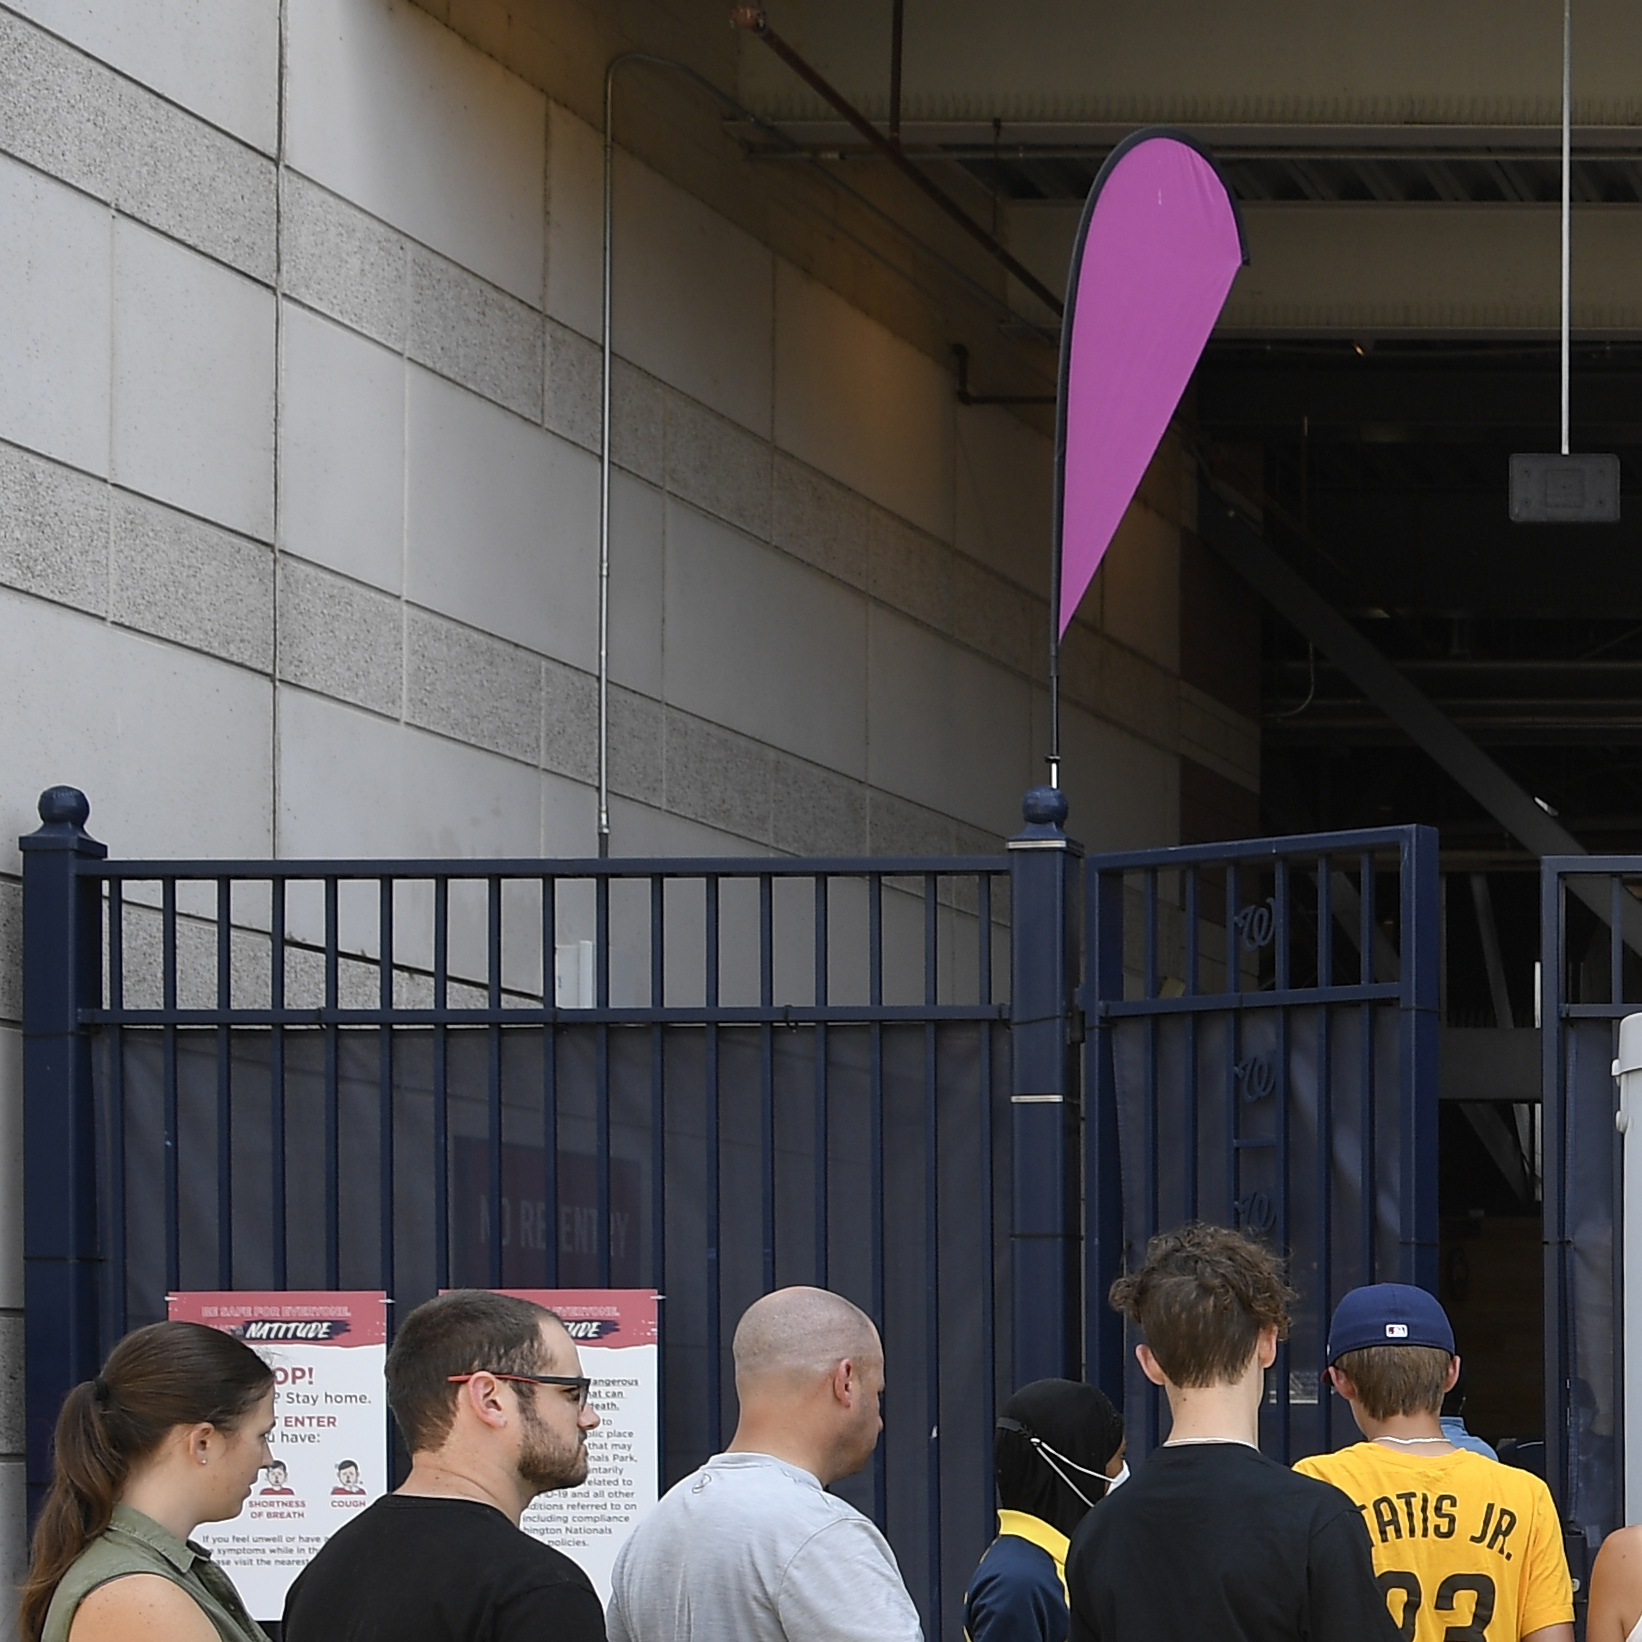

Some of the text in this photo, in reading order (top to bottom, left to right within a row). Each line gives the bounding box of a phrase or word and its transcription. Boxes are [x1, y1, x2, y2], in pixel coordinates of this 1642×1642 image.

[220, 1306, 252, 1317] SAFE
[254, 1306, 280, 1317] FOR
[246, 1321, 332, 1339] NATITUDE
[592, 1379, 639, 1387] angerous
[286, 1391, 319, 1406] Stay
[324, 1391, 372, 1404] home.
[284, 1416, 337, 1428] ENTER
[602, 1418, 612, 1426] to
[280, 1431, 320, 1443] have:
[606, 1430, 634, 1439] place
[612, 1455, 637, 1463] Park,
[622, 1479, 633, 1487] to
[571, 1490, 635, 1498] and all other
[248, 1500, 366, 1508] SHORTNESS COUGH
[567, 1503, 607, 1511] referred
[610, 1503, 621, 1511] to
[624, 1503, 637, 1511] on
[522, 1514, 630, 1524] including compliance
[1469, 1502, 1518, 1561] JR.
[202, 1535, 210, 1543] If
[211, 1537, 230, 1545] you
[232, 1535, 249, 1543] feel
[252, 1535, 283, 1543] unwell
[298, 1535, 321, 1543] have
[217, 1548, 266, 1556] symptoms
[269, 1546, 295, 1555] while
[297, 1546, 306, 1555] in
[234, 1558, 254, 1566] visit
[256, 1558, 272, 1566] the
